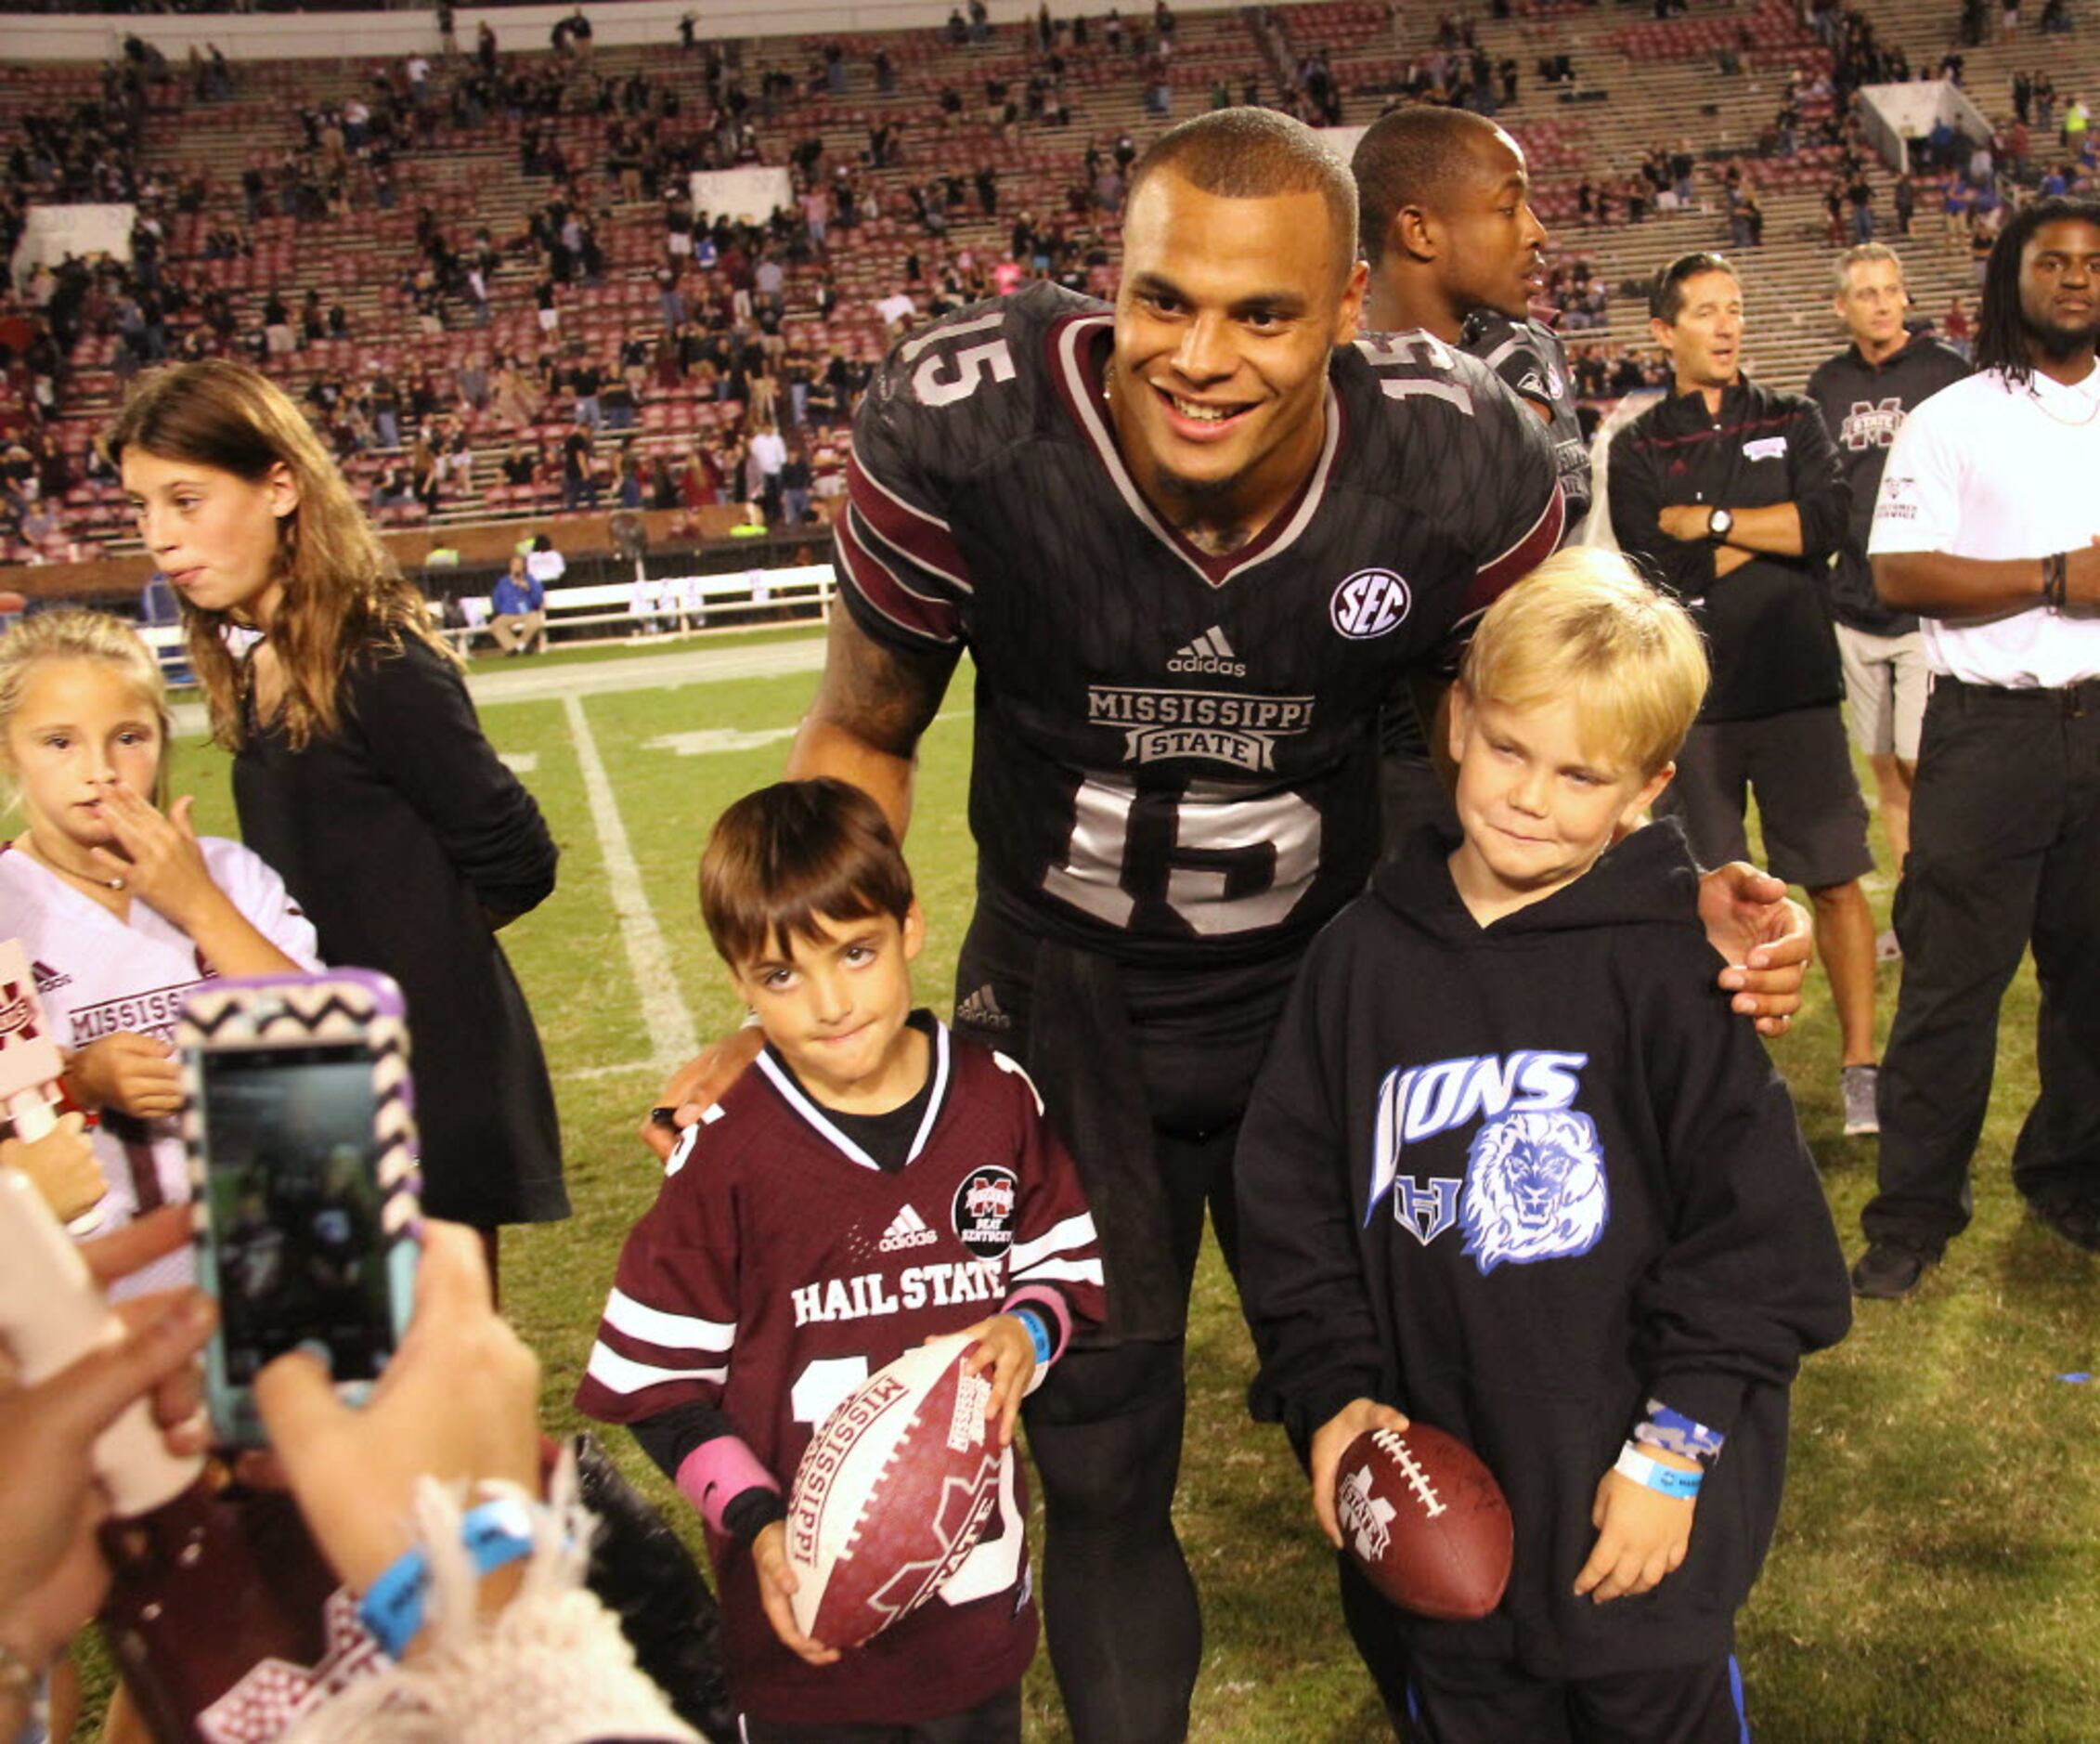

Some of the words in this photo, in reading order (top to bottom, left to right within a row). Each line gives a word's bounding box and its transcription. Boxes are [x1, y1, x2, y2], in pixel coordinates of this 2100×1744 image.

[901, 312, 1017, 407] 15
[1338, 575, 1404, 634] SEC
[1166, 656, 1246, 677] adidas
[1088, 692, 1315, 728] MISSISSIPPI
[1151, 733, 1251, 762] STATE
[1042, 772, 1322, 937] 15
[879, 1230, 938, 1252] adidas
[791, 1273, 899, 1328] HAIL
[900, 1260, 1005, 1309] STATE
[795, 1375, 905, 1567] MISSISSIPPI
